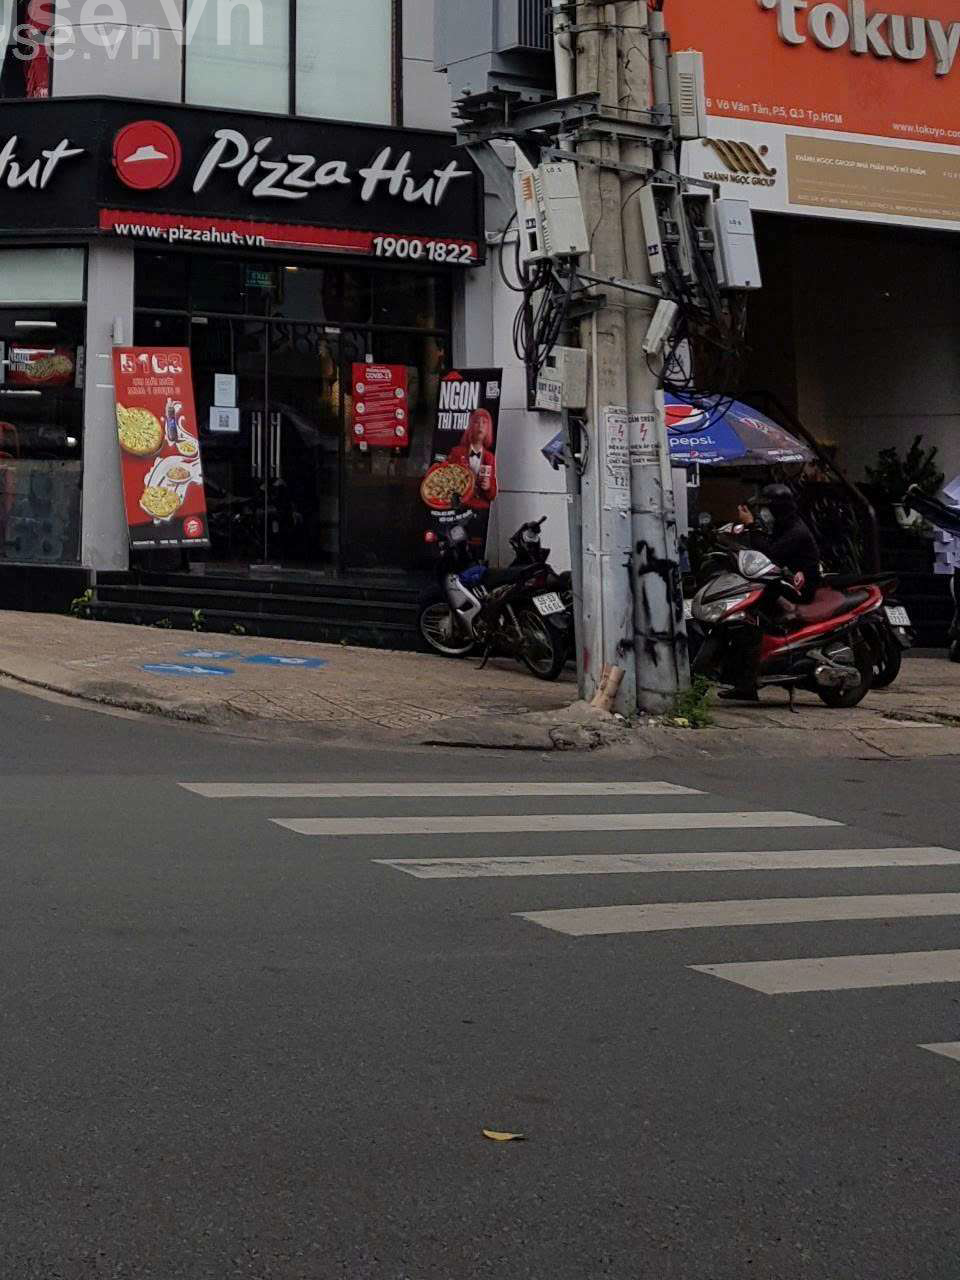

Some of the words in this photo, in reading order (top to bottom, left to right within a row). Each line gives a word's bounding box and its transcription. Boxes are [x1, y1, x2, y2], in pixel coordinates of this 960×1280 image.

[192, 128, 351, 199] Pizza
[359, 146, 473, 206] Hut
[114, 222, 265, 248] www.pizzahut.vn
[373, 236, 424, 260] 1900
[427, 239, 473, 265] 1822
[441, 381, 480, 410] NGON
